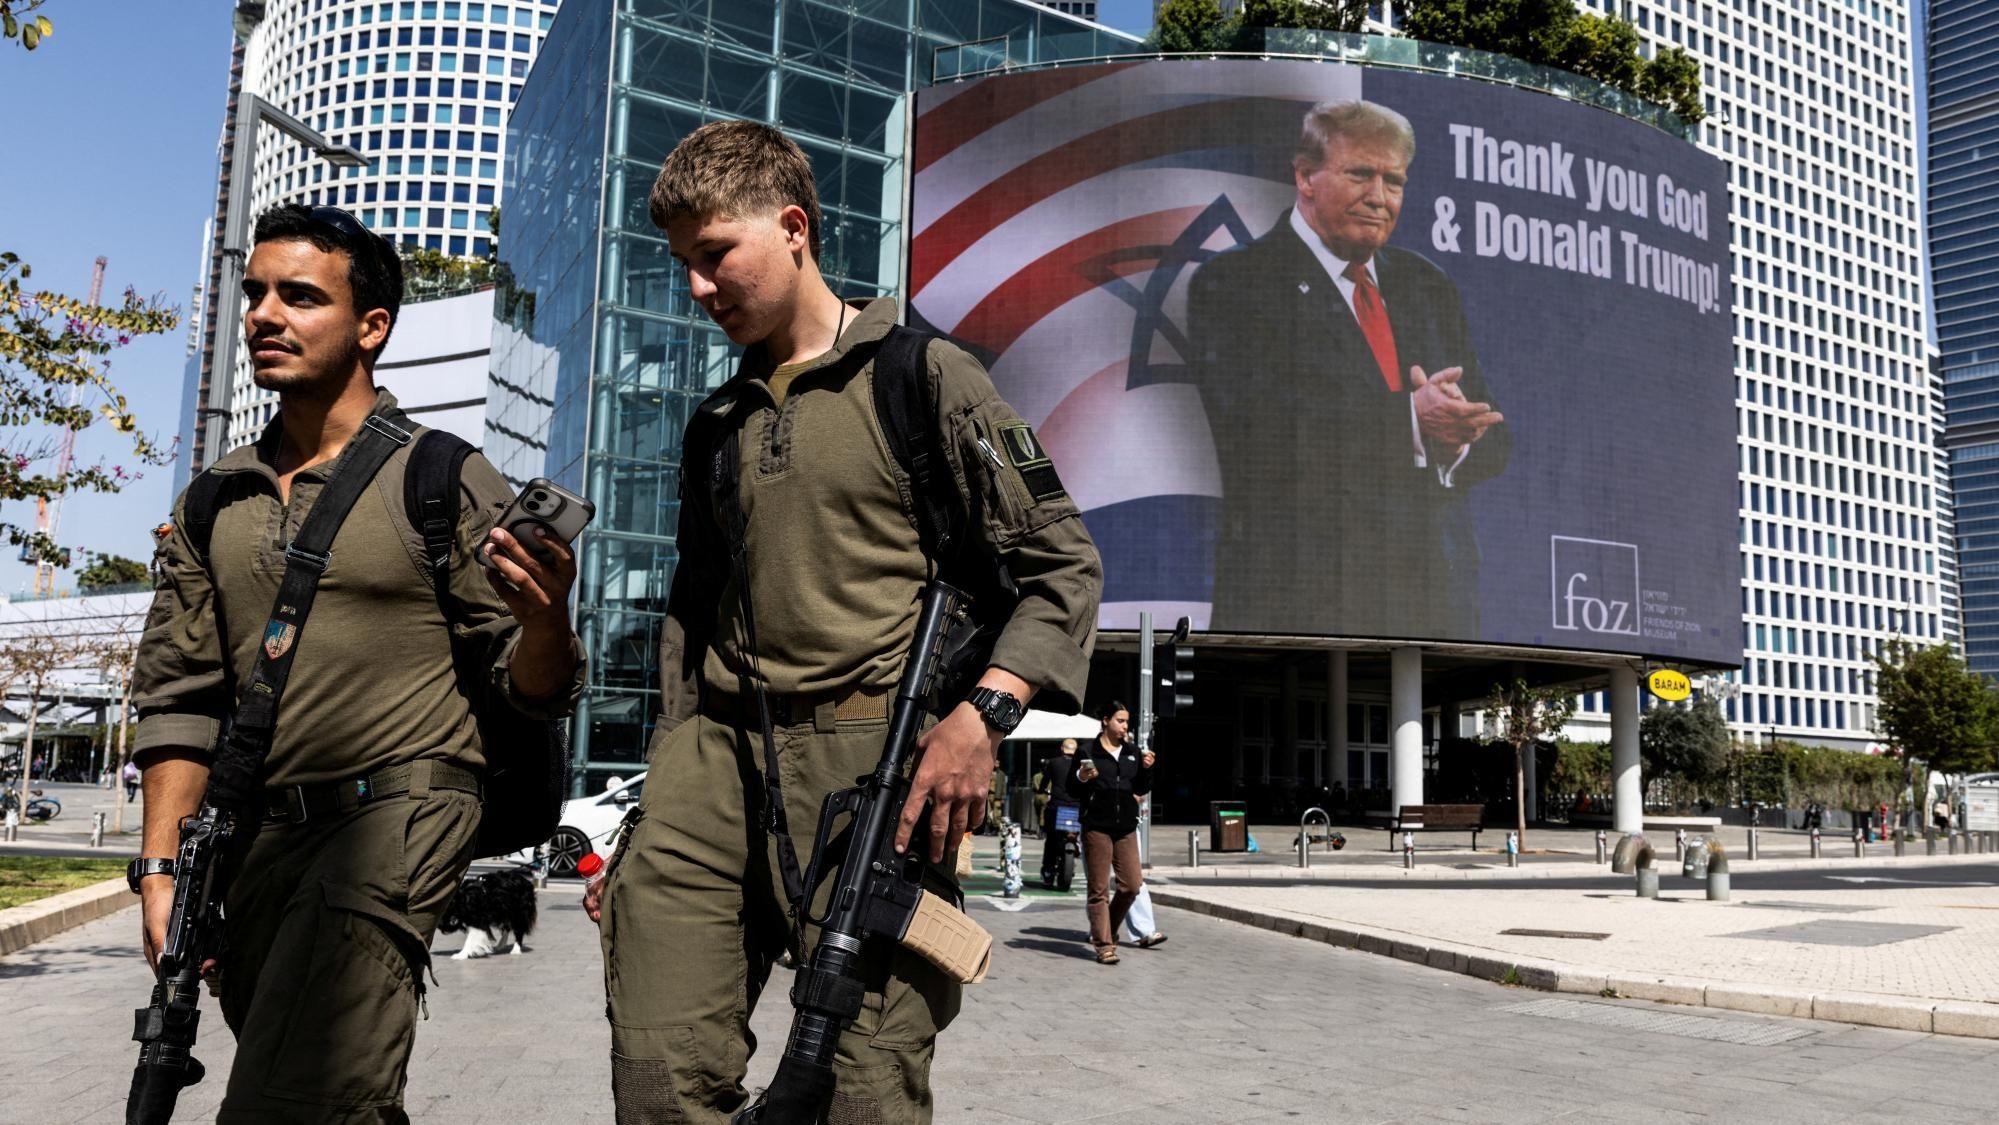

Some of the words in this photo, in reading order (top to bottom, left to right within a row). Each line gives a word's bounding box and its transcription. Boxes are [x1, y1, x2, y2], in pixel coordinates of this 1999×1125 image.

[1449, 123, 1576, 199] Thank
[1585, 157, 1648, 219] you
[1657, 174, 1709, 241] God
[1431, 196, 1461, 253] &
[1475, 201, 1612, 279] Donald
[1620, 230, 1720, 314] Trump!
[1564, 572, 1633, 632] foz
[1643, 616, 1674, 630] FRIENDS
[1675, 620, 1684, 630] OF
[1643, 628, 1677, 640] MUSEUM
[1654, 678, 1686, 693] BARAM
